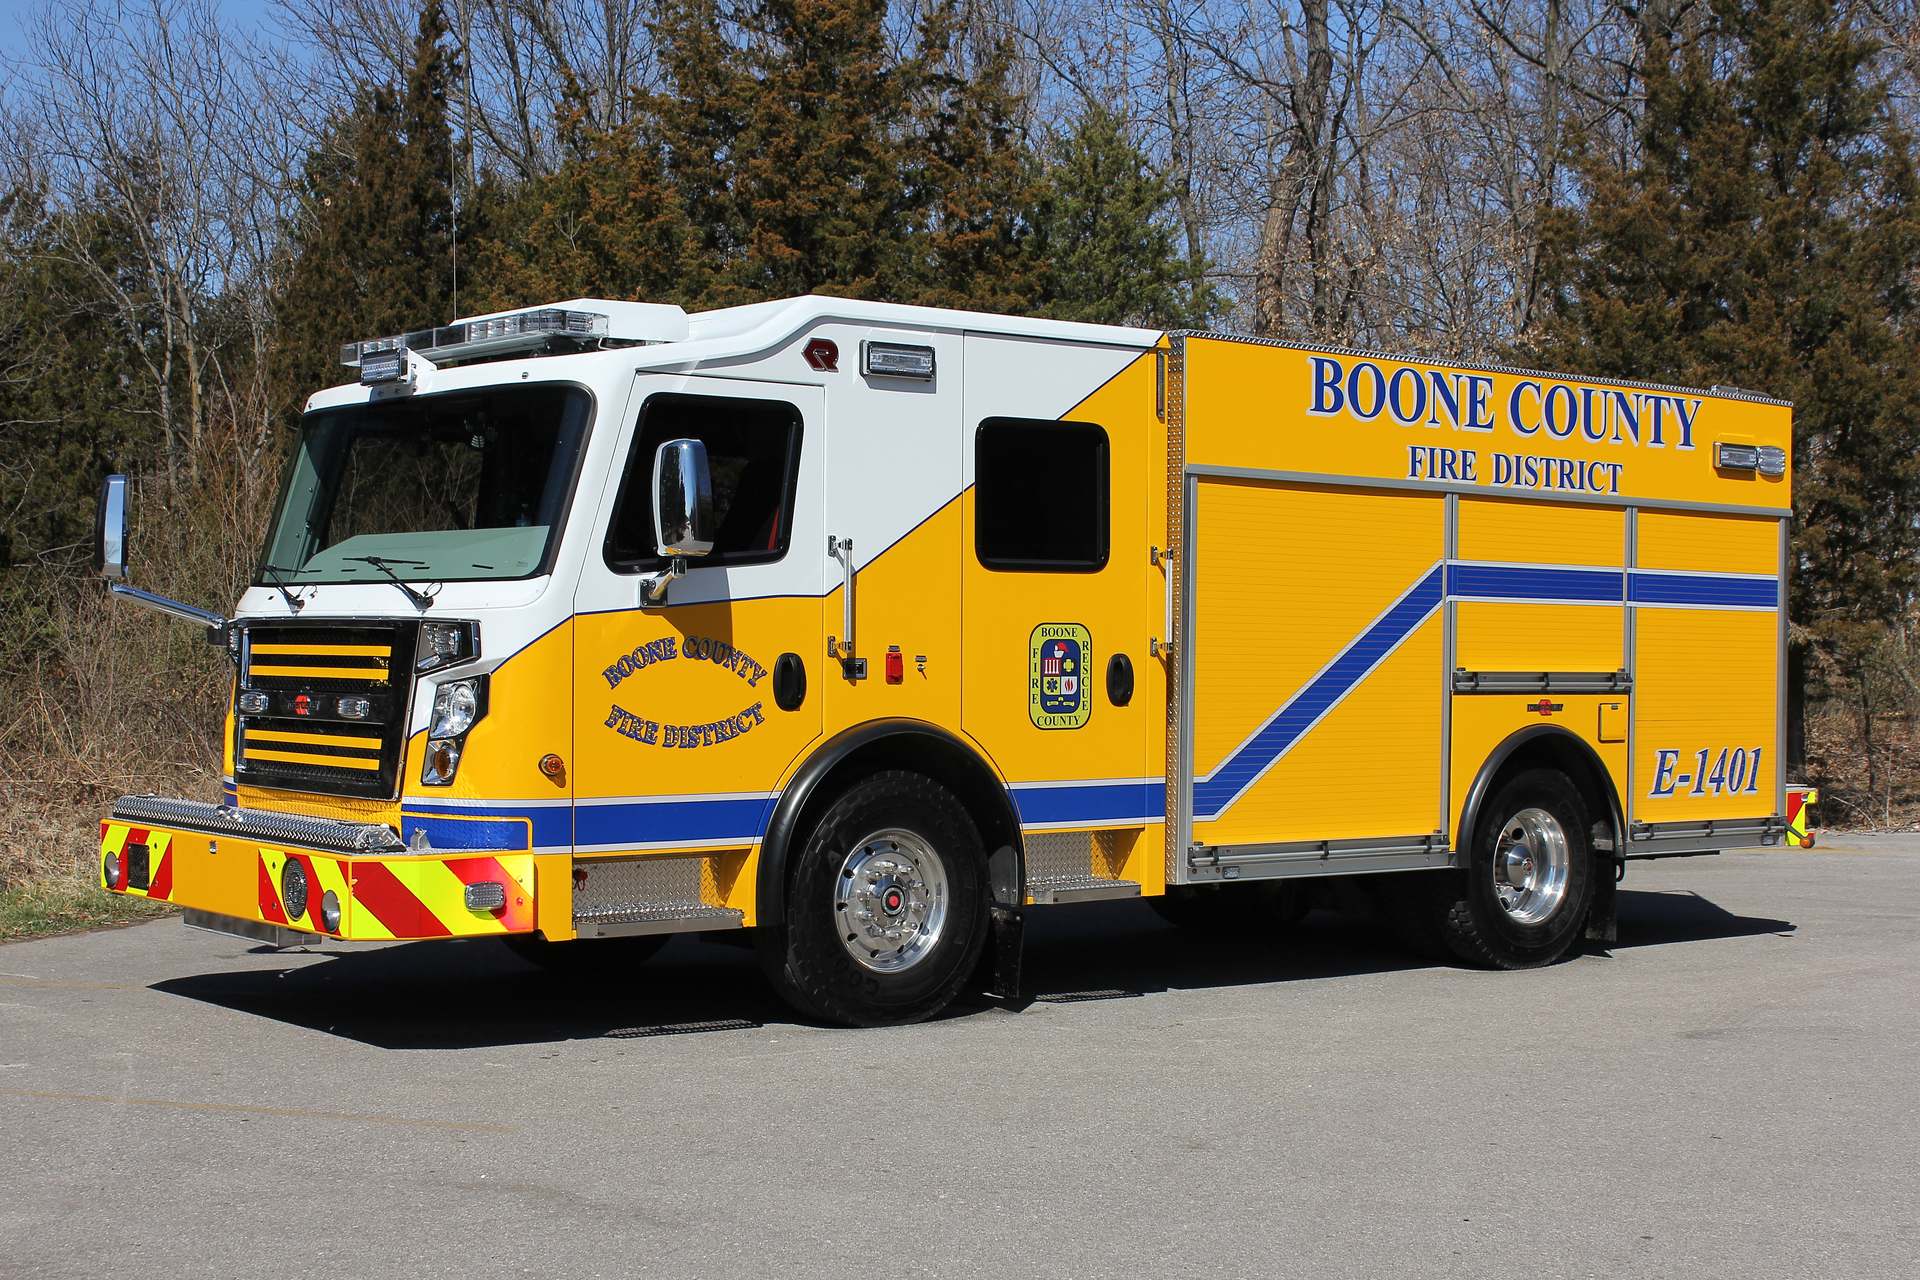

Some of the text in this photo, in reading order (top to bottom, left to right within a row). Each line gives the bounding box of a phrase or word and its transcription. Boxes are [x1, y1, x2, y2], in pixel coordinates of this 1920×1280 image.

[1306, 355, 1703, 451] BOONE COUNTY
[1405, 445, 1624, 496] FIRE DISTRICT
[1041, 627, 1078, 637] BOONE
[602, 635, 768, 690] BOONE COUNTY
[604, 701, 766, 749] FIRE DISTRICT
[1037, 716, 1080, 726] COUNTY
[1646, 746, 1762, 799] E-1401
